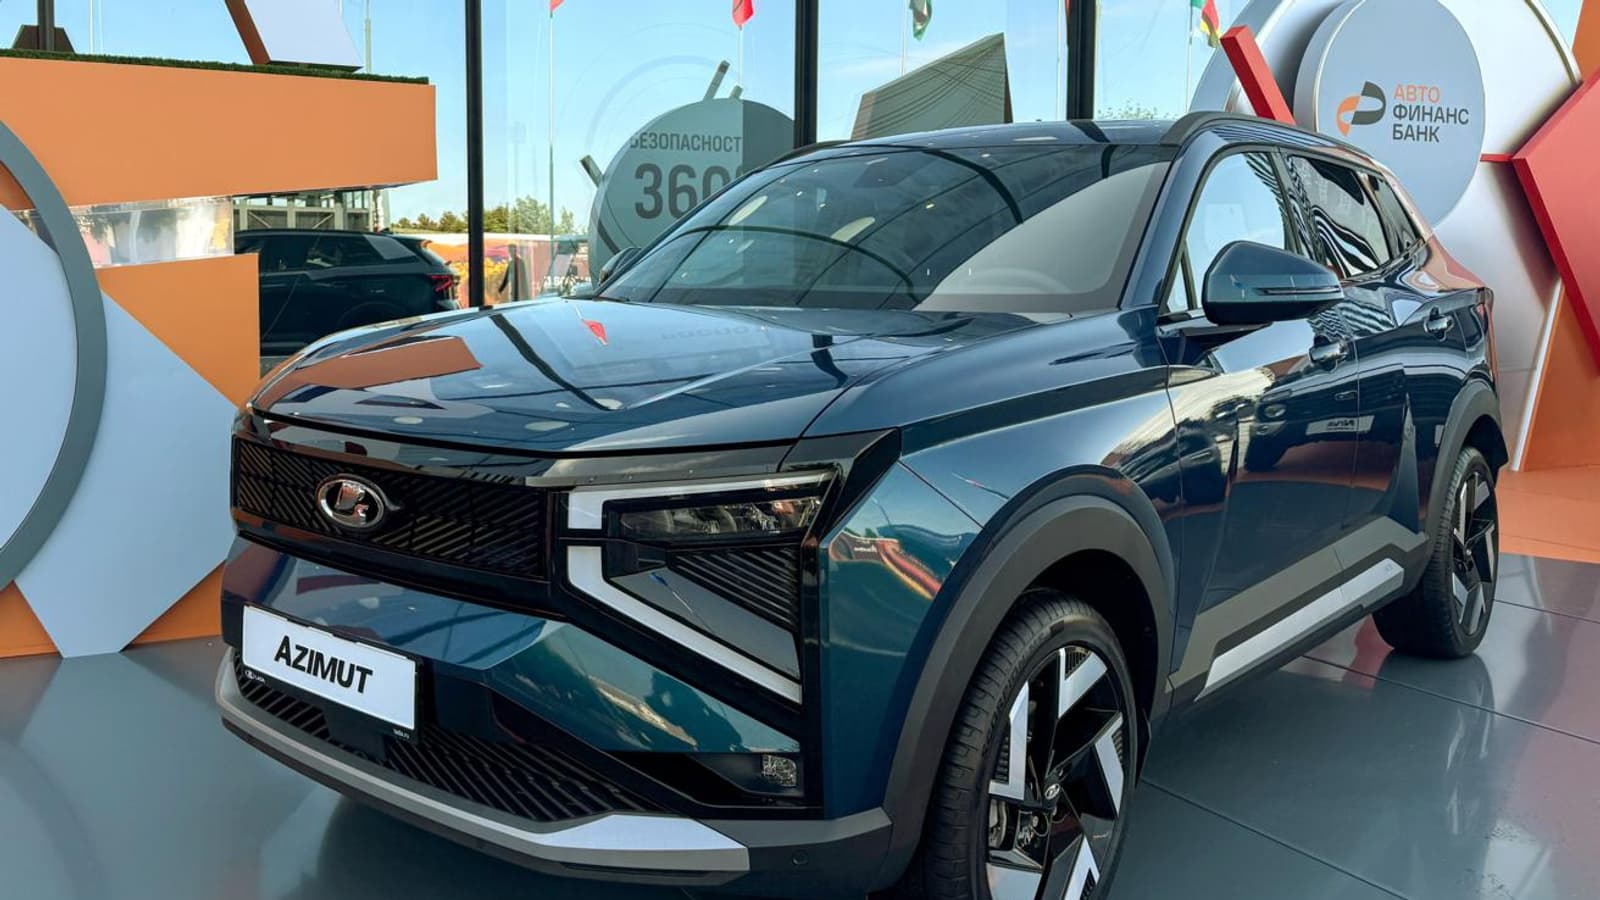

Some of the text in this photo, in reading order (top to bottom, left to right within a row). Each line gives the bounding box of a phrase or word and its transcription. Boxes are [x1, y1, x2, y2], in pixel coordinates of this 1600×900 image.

[1394, 84, 1440, 103] АВТО
[1392, 103, 1470, 126] ФИНАНС
[1392, 124, 1440, 143] БАНК
[274, 635, 373, 694] AZIMUT
